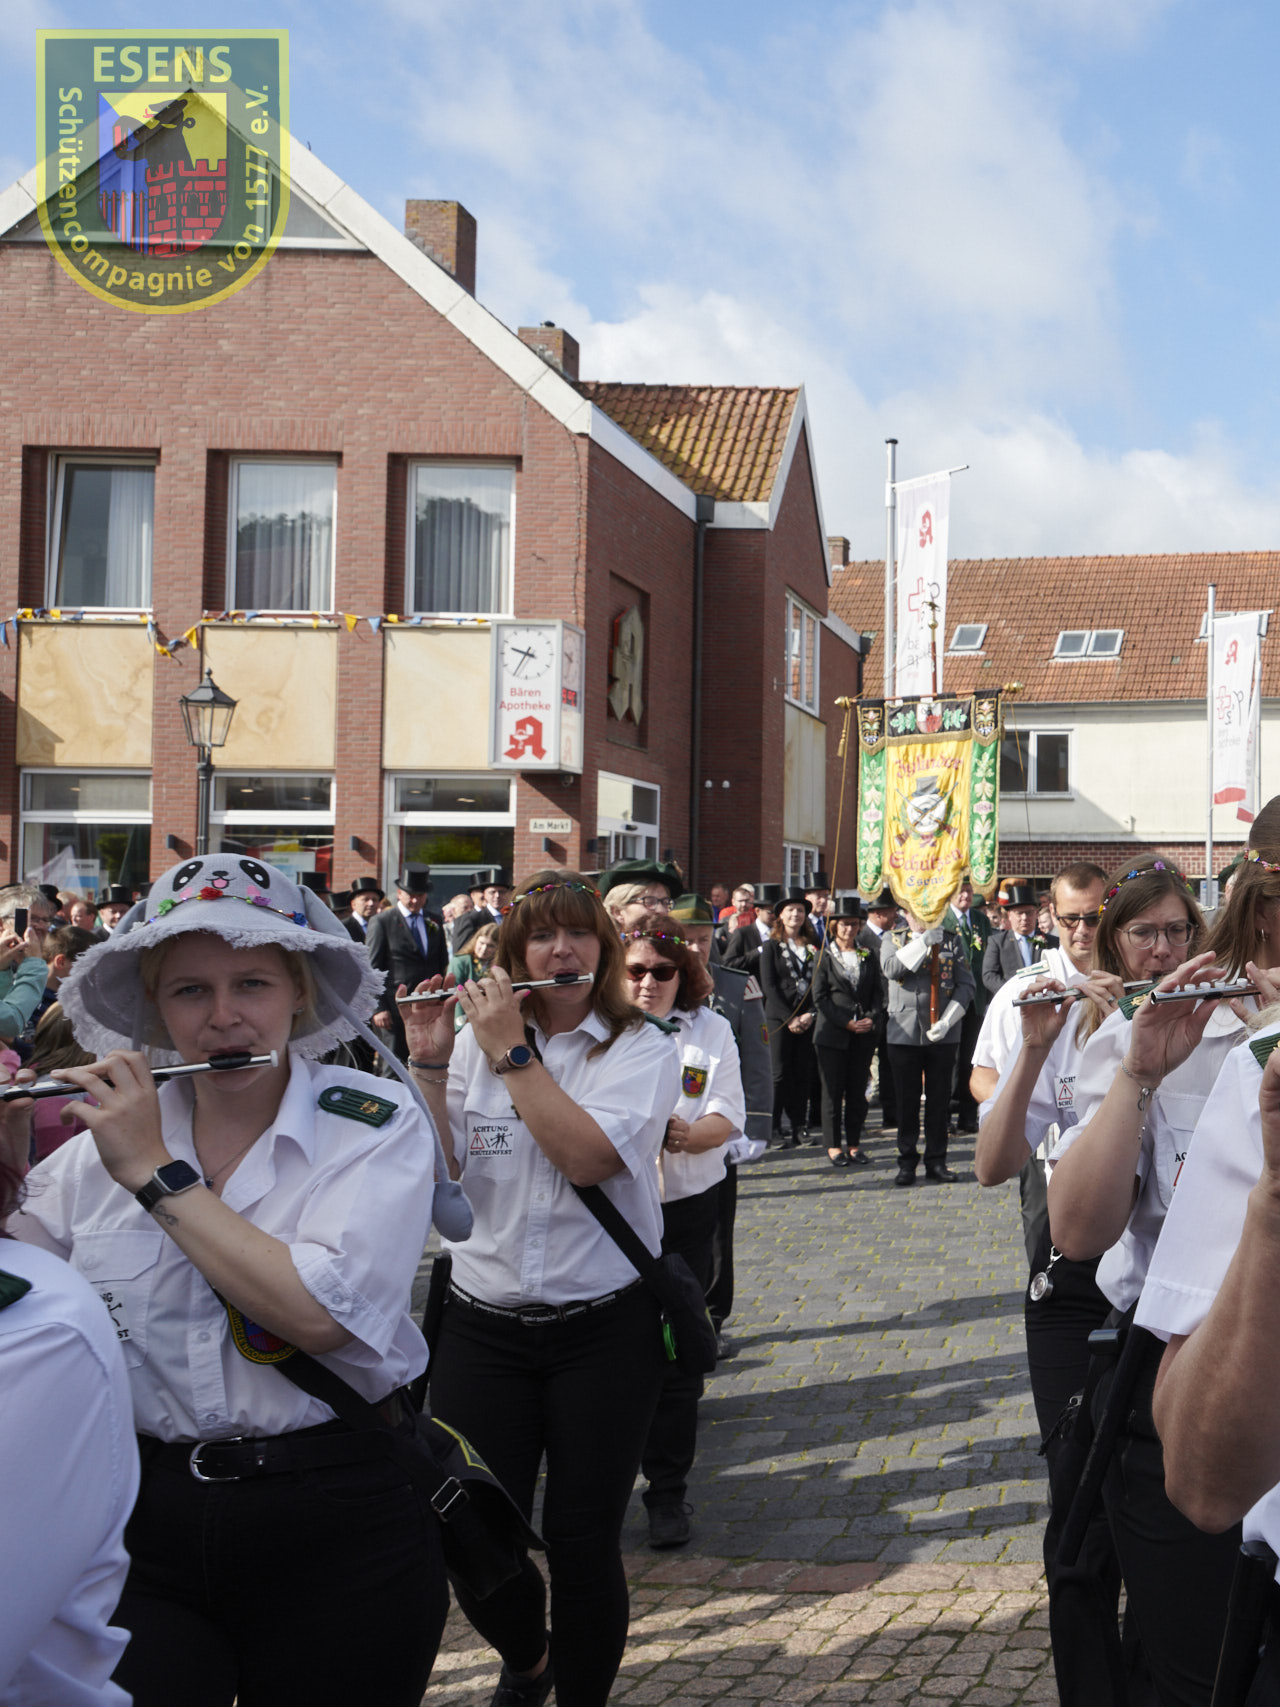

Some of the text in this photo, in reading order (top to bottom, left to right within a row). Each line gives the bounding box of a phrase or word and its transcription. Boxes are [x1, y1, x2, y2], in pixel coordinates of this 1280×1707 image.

[510, 687, 541, 697] Bären
[499, 700, 551, 711] Apotheke
[533, 821, 569, 829] Am Markt
[906, 875, 945, 887] Esens
